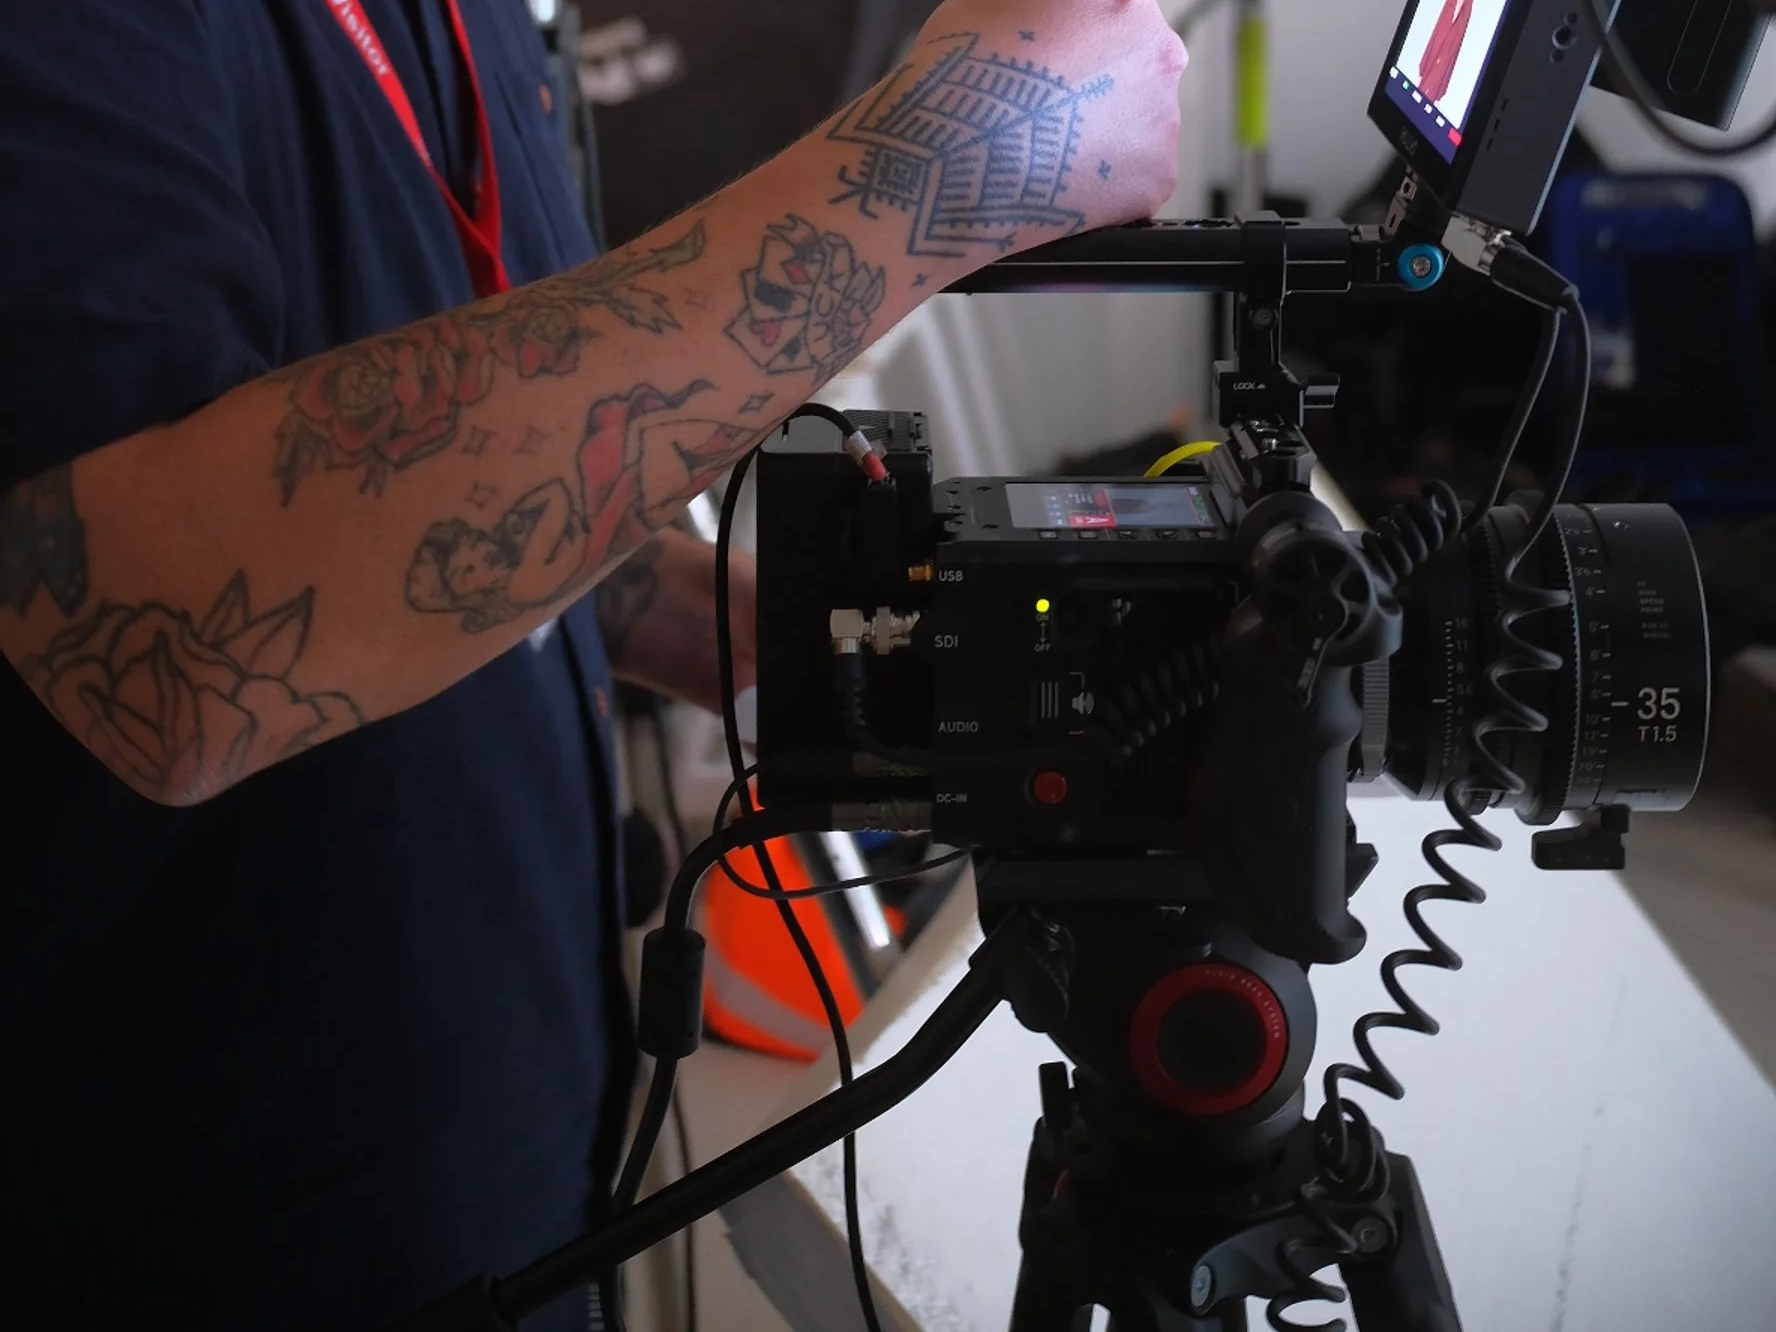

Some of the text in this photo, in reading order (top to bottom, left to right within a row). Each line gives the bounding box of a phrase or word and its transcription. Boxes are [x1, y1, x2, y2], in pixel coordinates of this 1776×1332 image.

[1233, 381, 1255, 390] LOCK
[938, 570, 963, 582] USB
[934, 635, 959, 648] SDI
[1033, 643, 1051, 653] OFF
[1637, 687, 1681, 720] 35
[938, 722, 979, 733] AUDIO
[1638, 725, 1678, 743] T1.5
[936, 793, 968, 803] DC-IN
